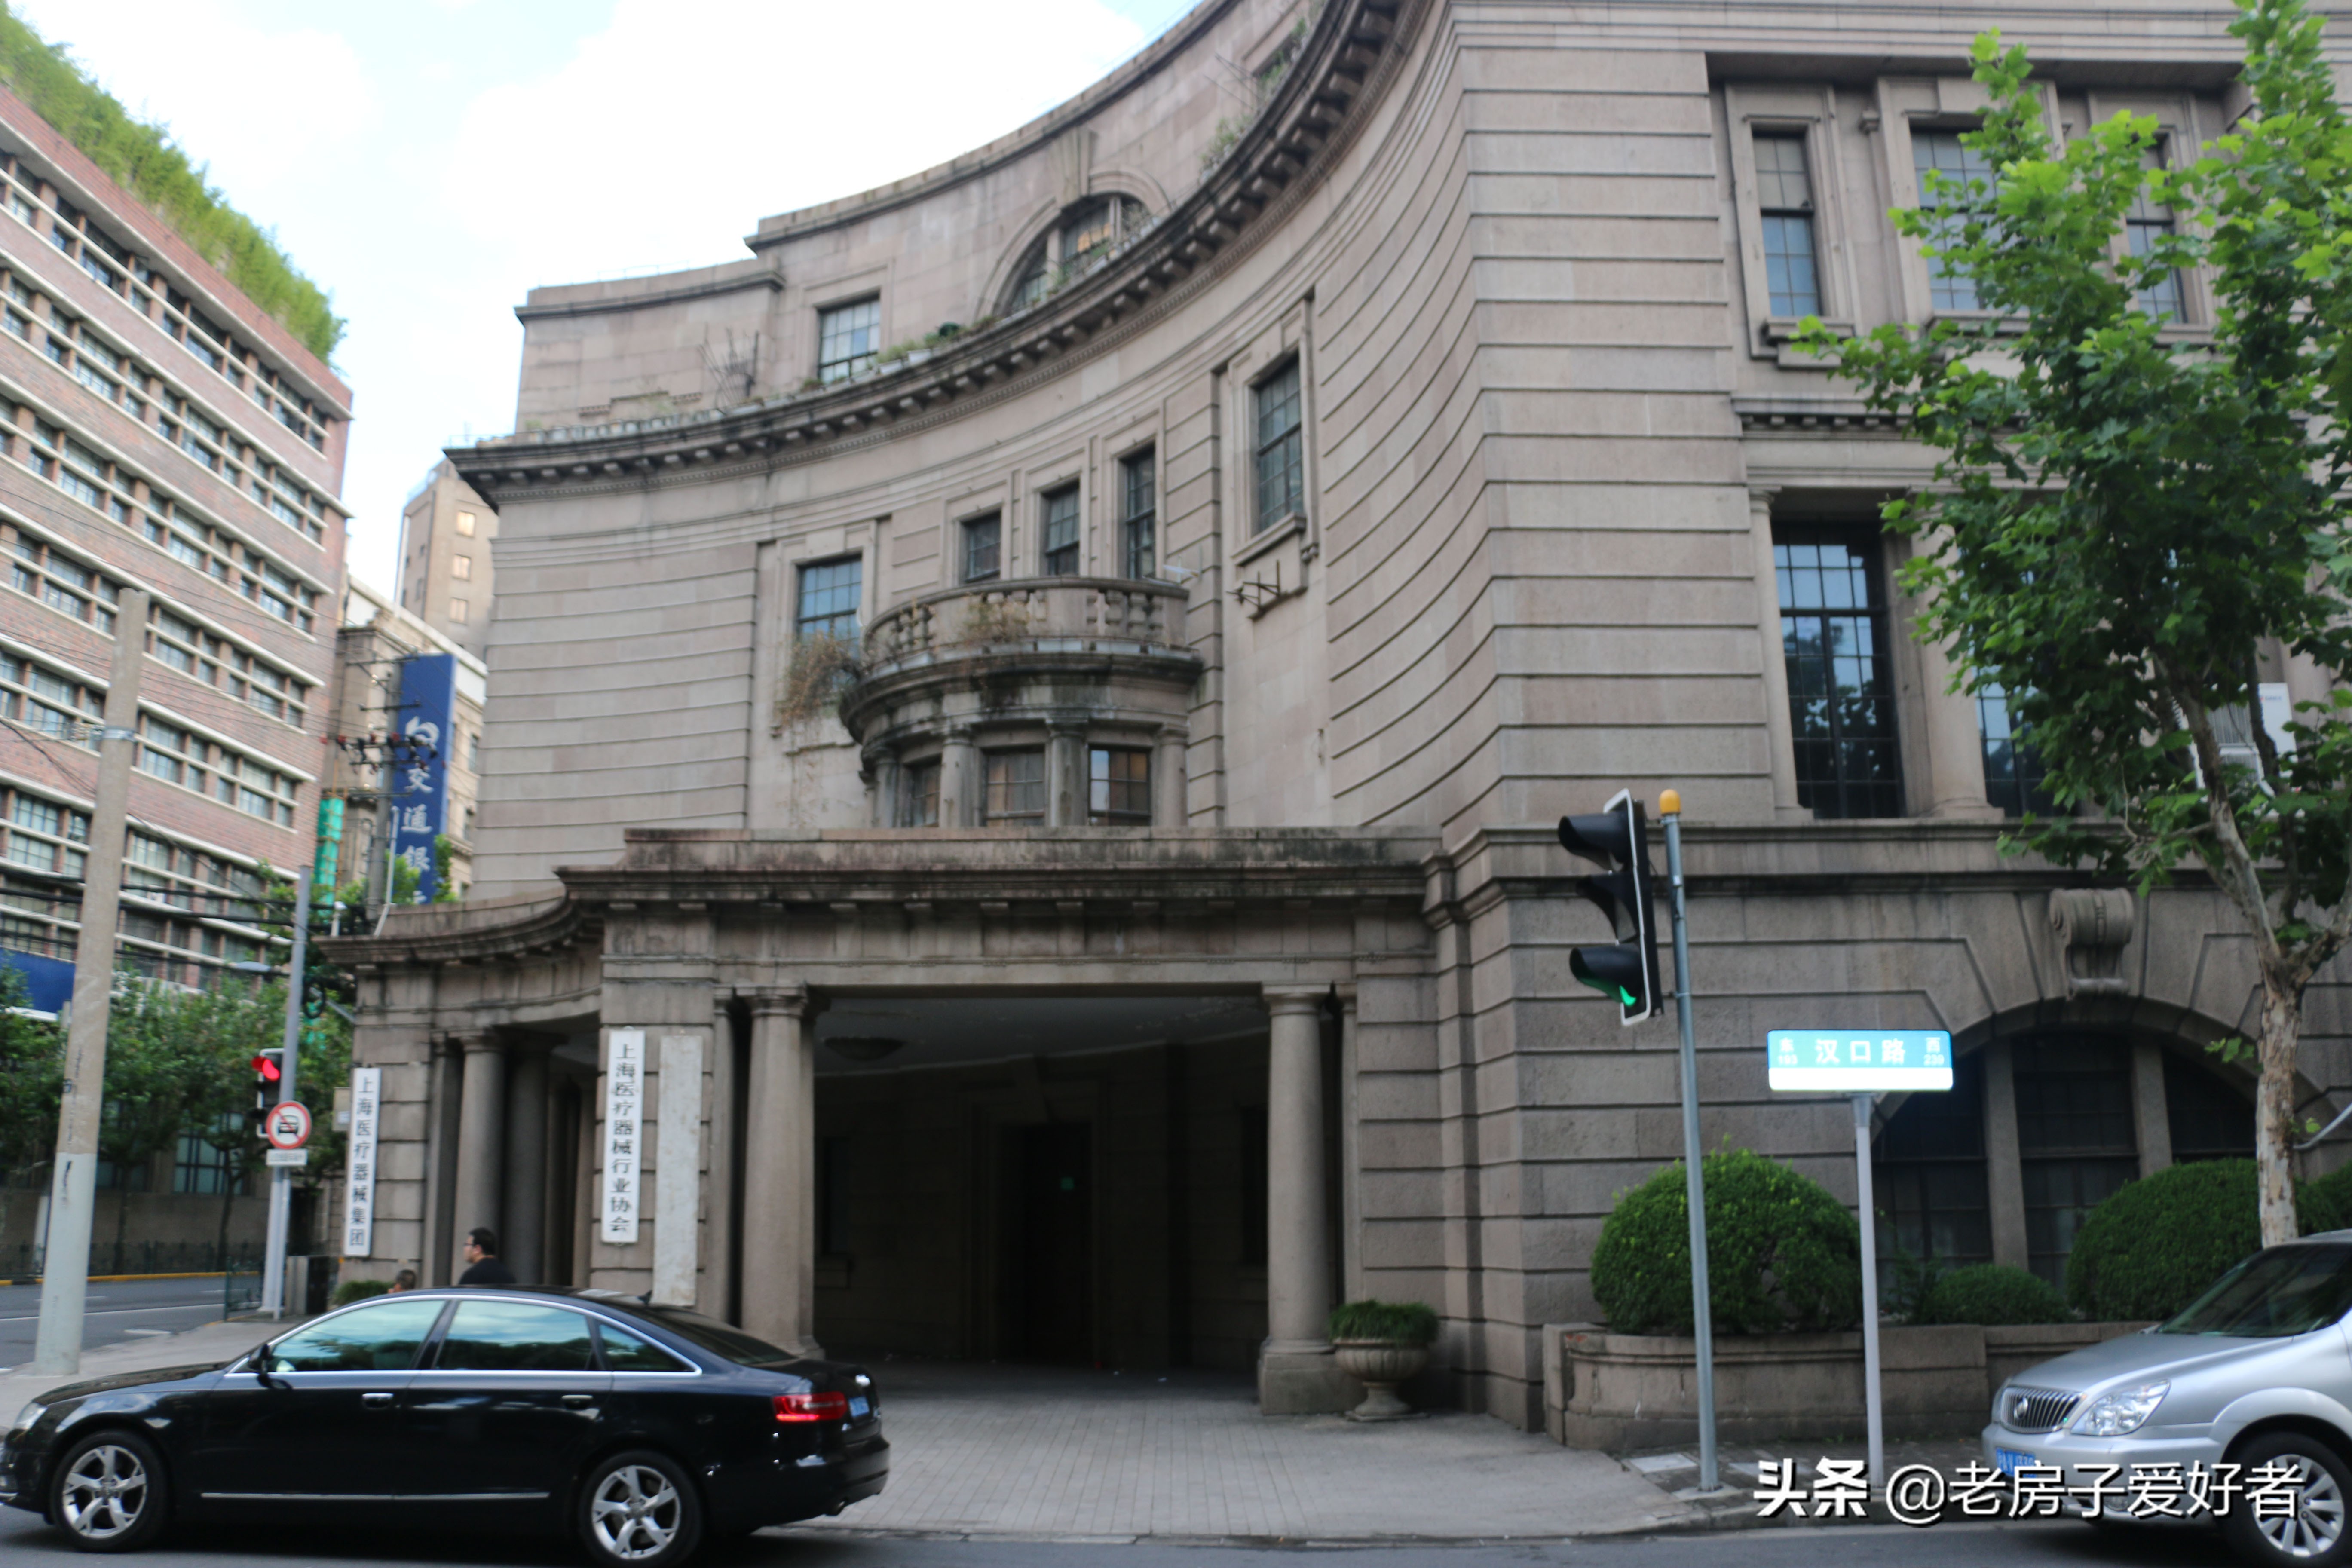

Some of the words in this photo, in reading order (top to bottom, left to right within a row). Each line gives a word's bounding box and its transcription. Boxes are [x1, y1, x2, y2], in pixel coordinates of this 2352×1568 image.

[401, 764, 434, 903] 交通银
[1780, 1038, 1794, 1052] 东
[1816, 1038, 1905, 1064] 汉口路
[1926, 1037, 1941, 1054] 西
[349, 1076, 374, 1246] 上海医疗器械集团
[610, 1043, 637, 1232] 上海医疗器械行业协会
